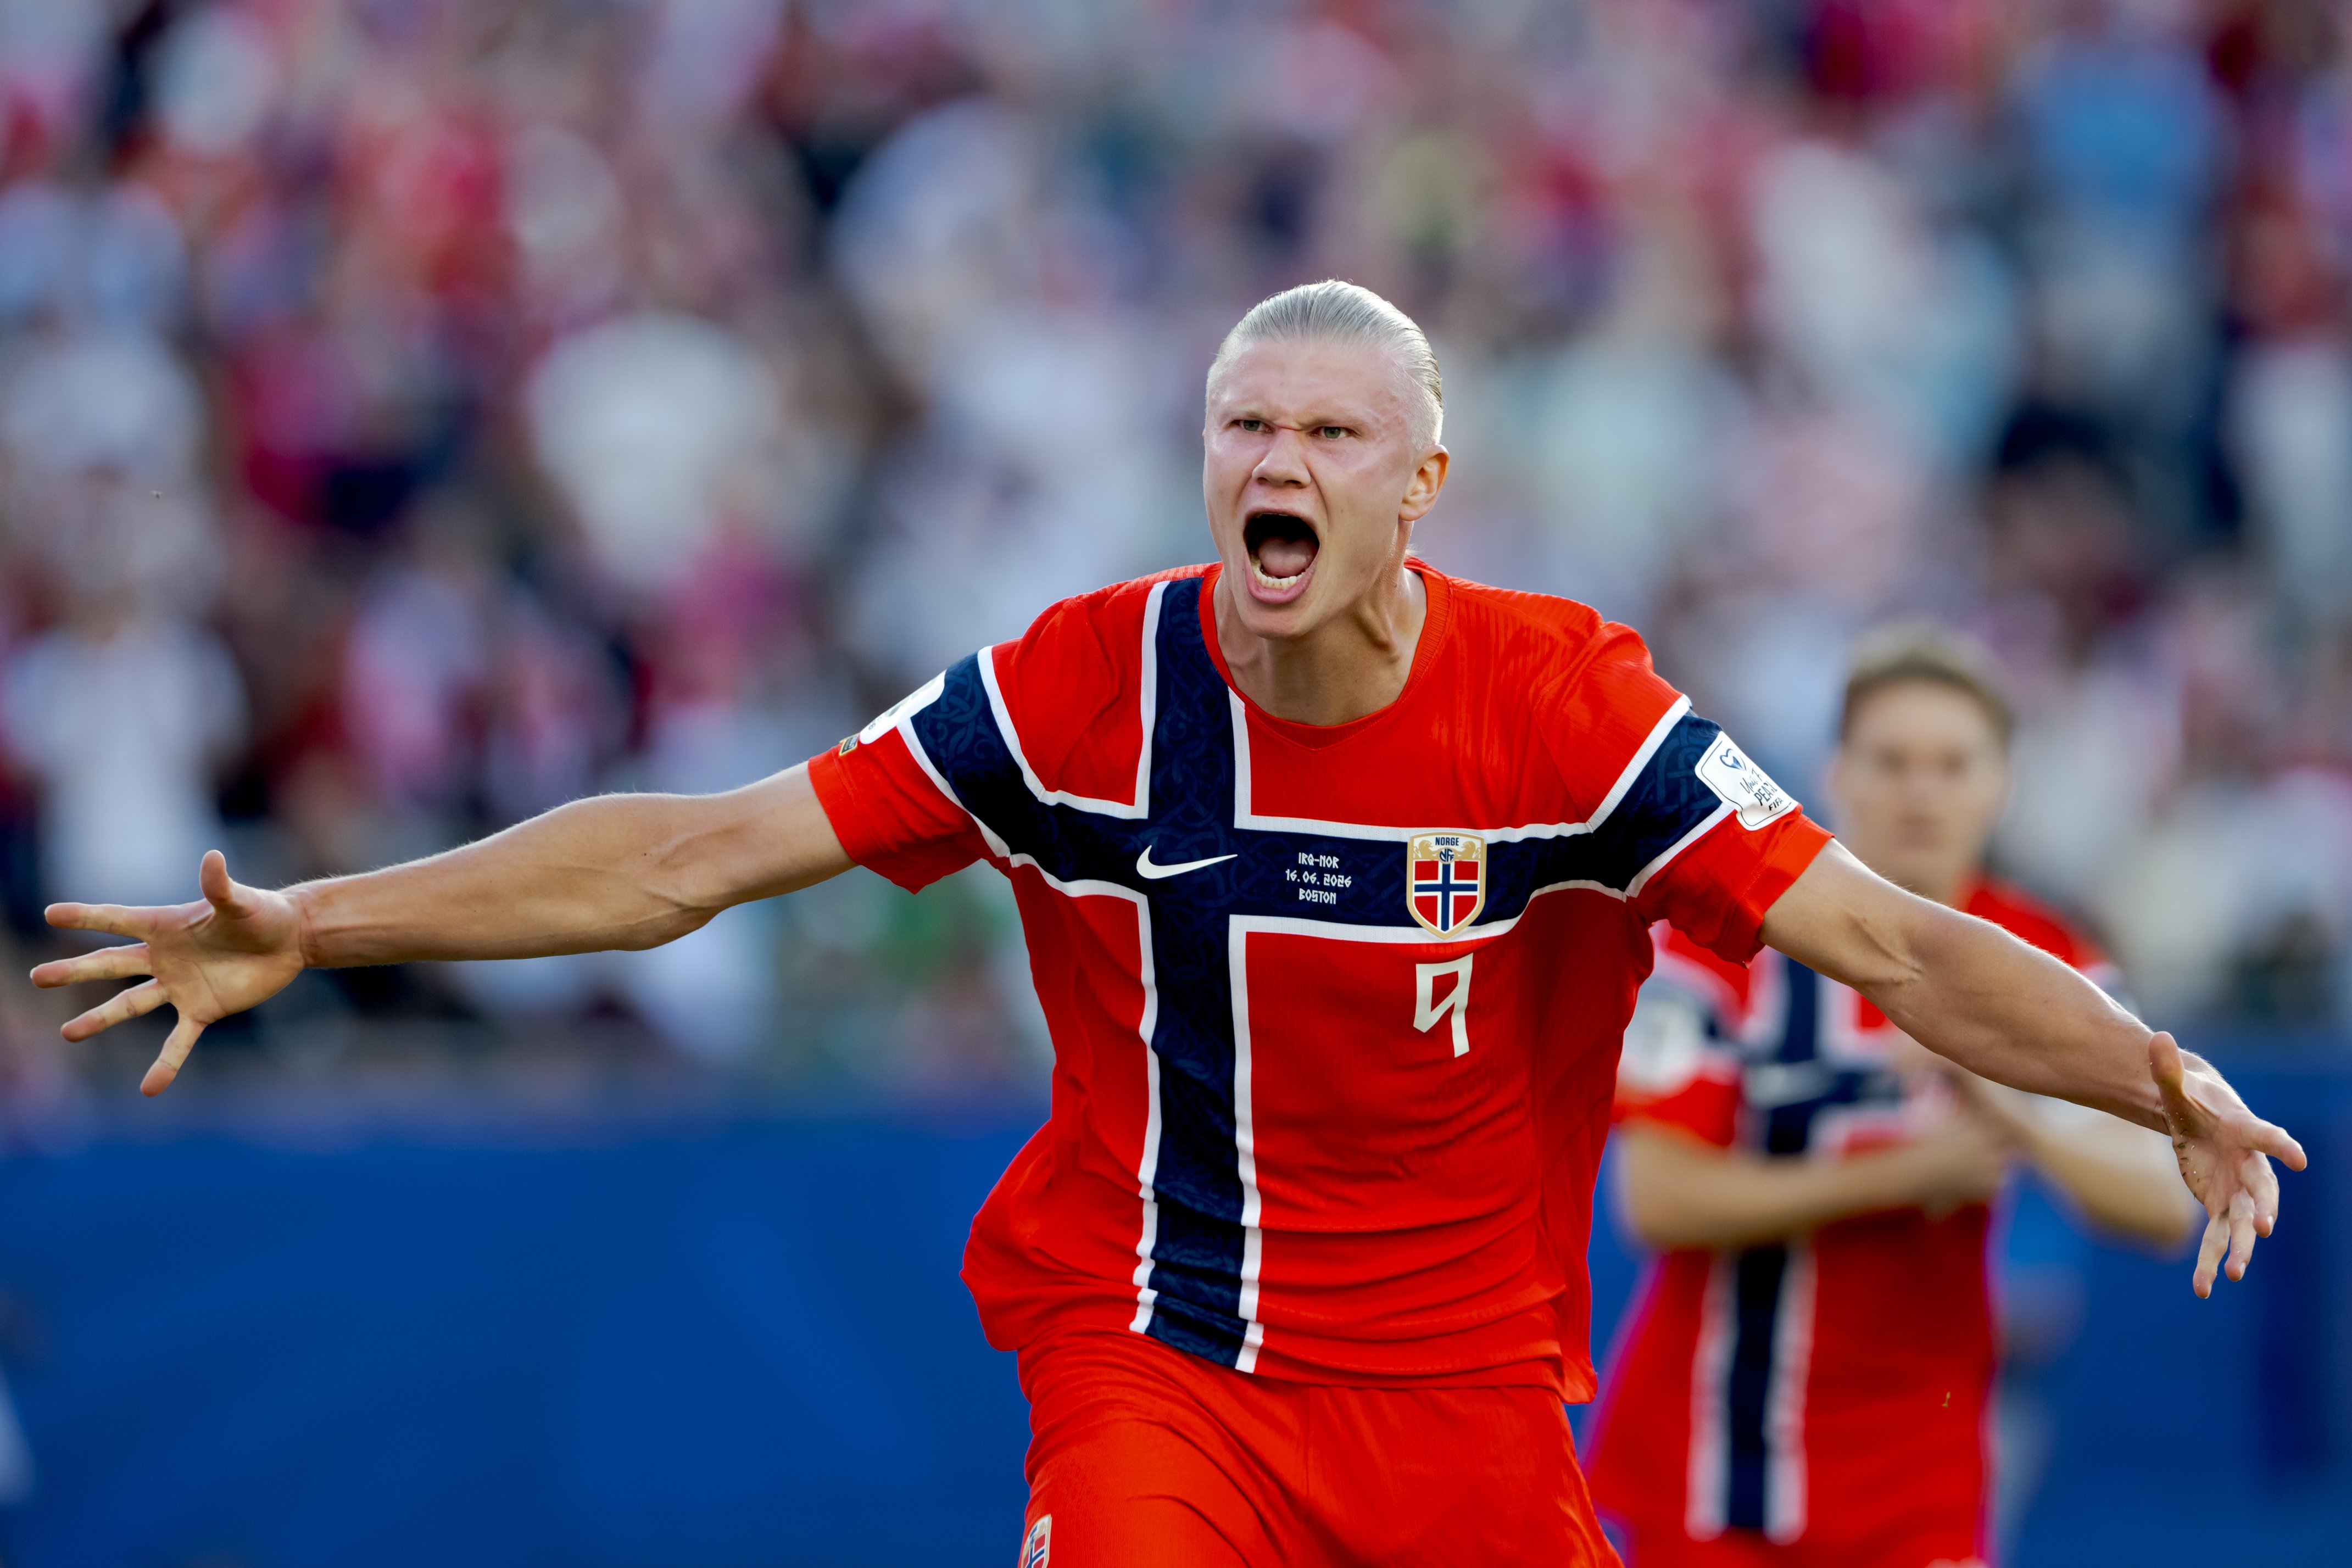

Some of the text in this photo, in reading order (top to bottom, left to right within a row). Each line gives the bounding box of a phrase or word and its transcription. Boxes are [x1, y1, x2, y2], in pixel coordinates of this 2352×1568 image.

[1769, 797, 1783, 811] FIFA
[1435, 837, 1459, 846] NORGE
[1298, 852, 1340, 869] IRQ-NOR
[1299, 888, 1336, 905] BOSTON
[1413, 952, 1473, 1058] 9
